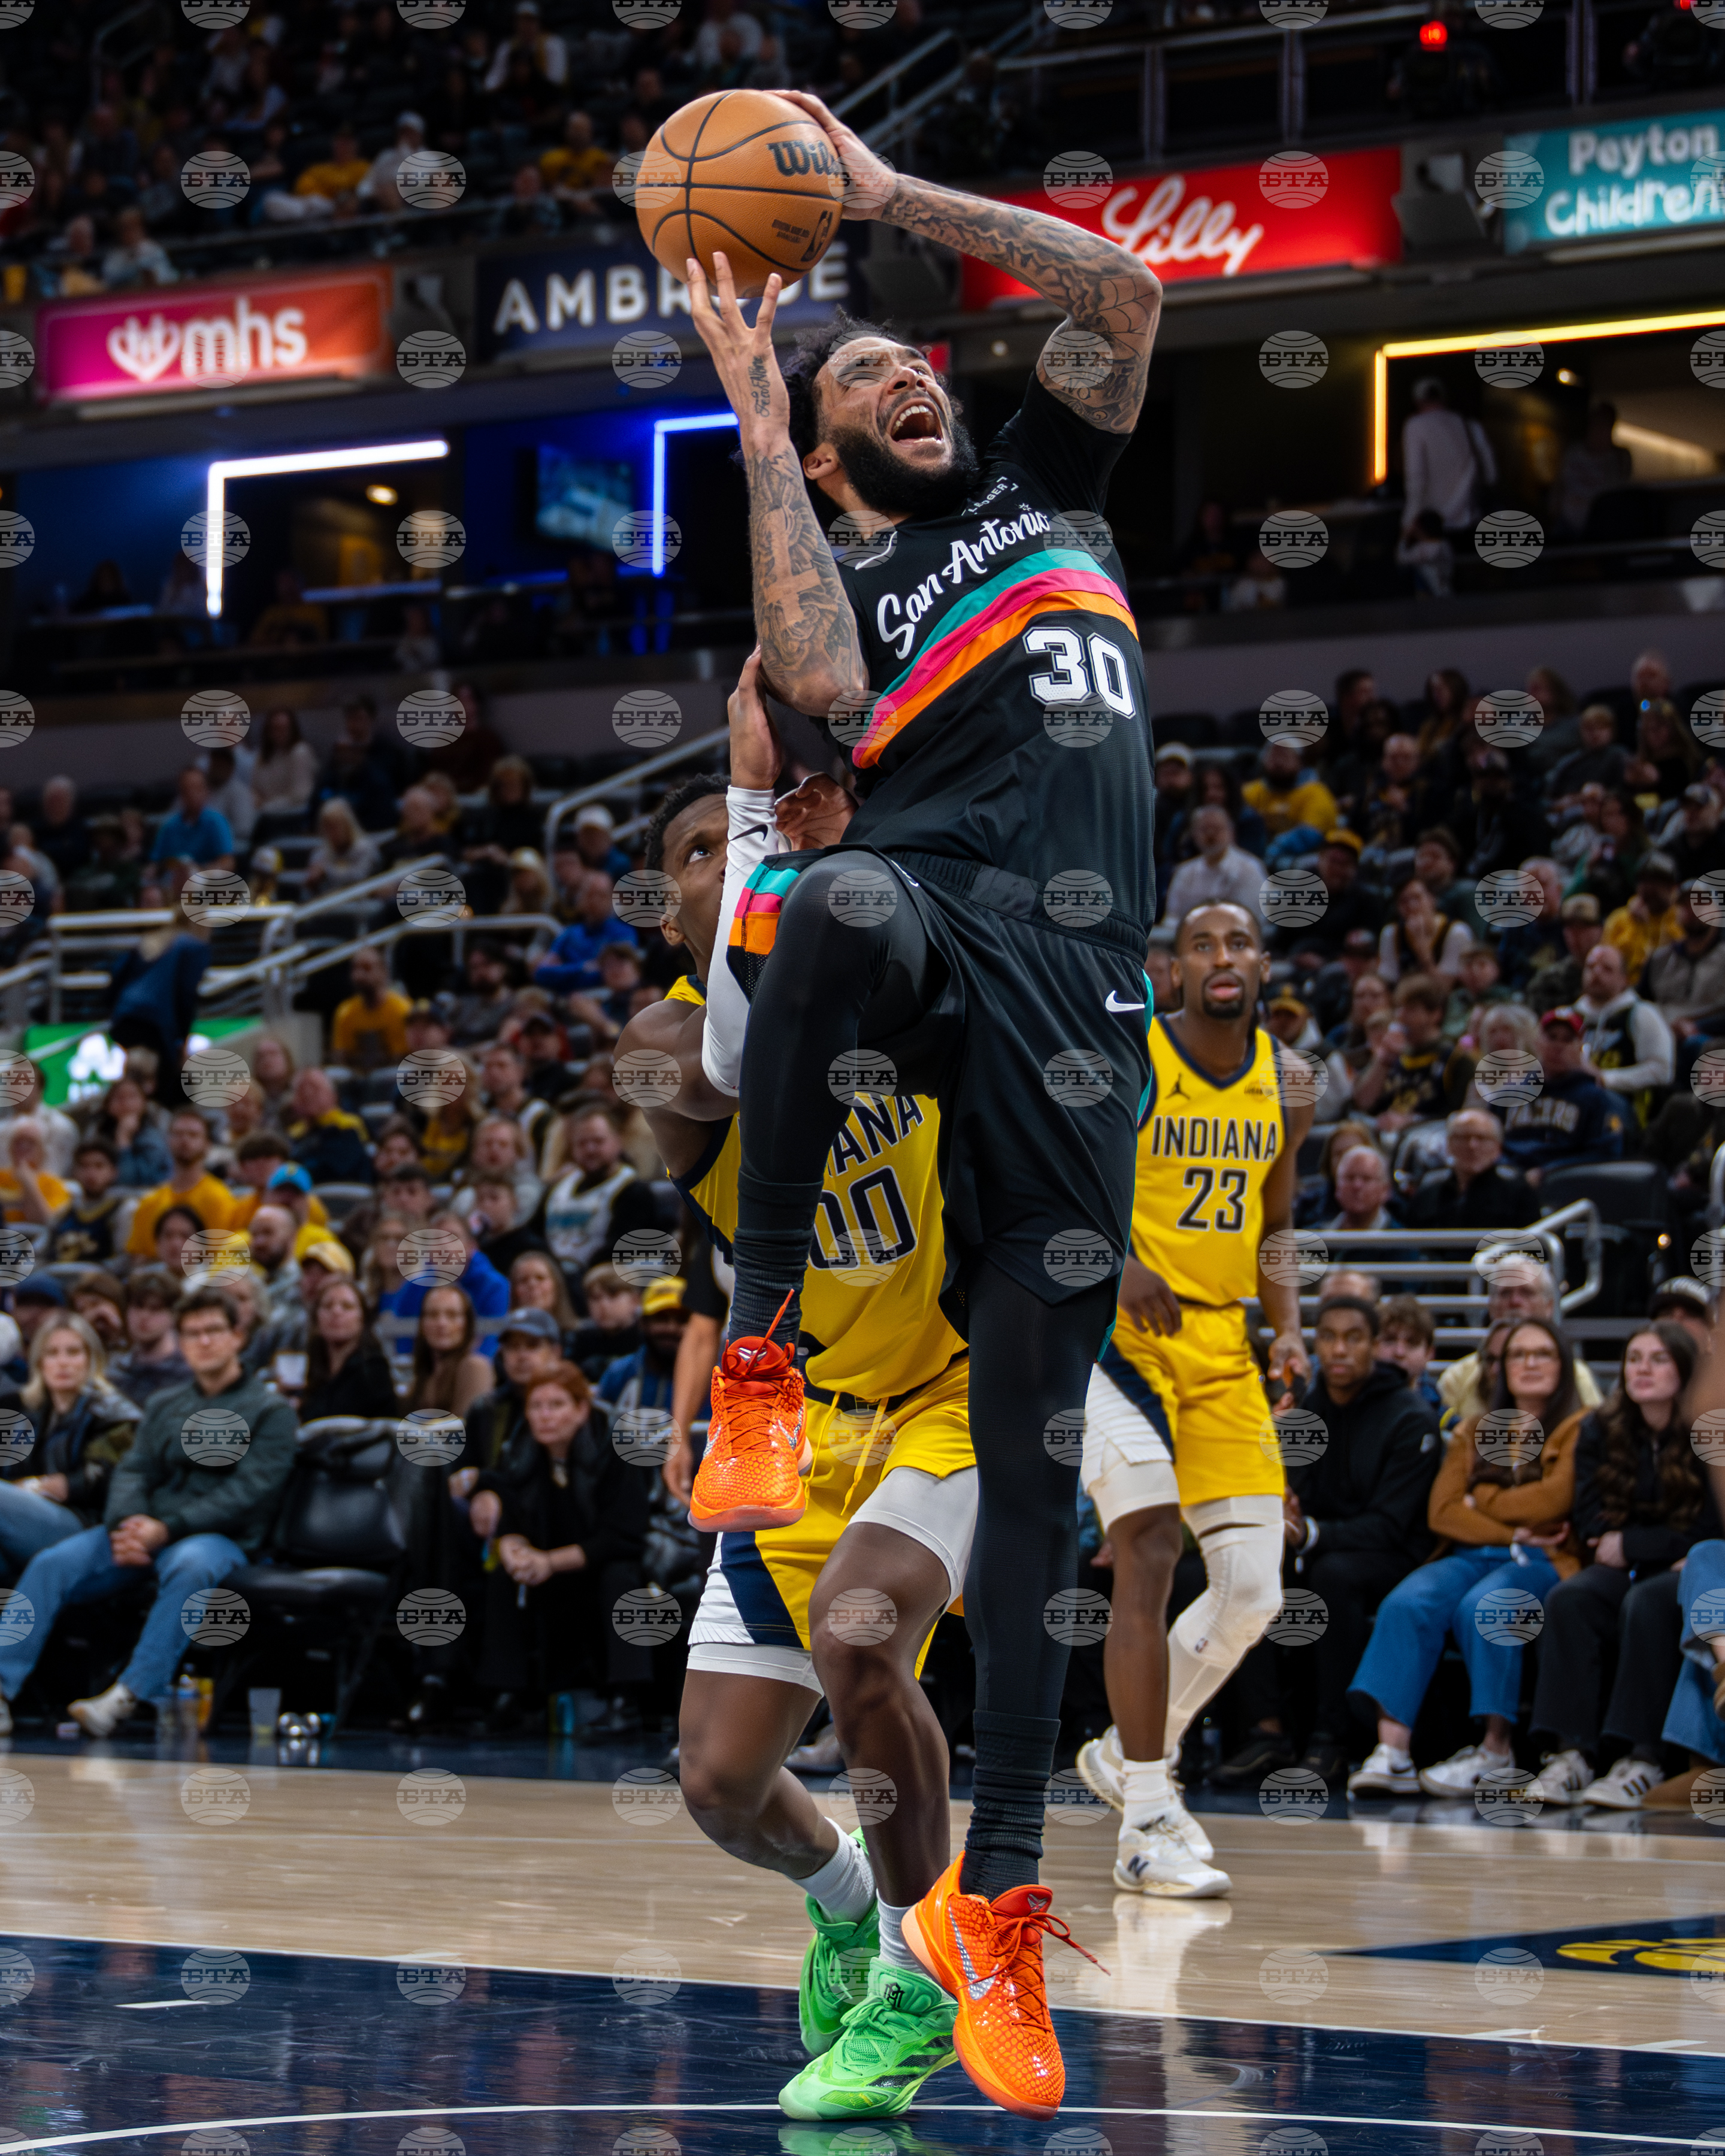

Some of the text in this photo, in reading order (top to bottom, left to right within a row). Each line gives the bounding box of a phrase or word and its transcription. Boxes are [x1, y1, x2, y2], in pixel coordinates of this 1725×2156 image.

[1567, 122, 1720, 178] Peyton
[1101, 172, 1265, 278] Lilly
[184, 296, 307, 376] mhs
[968, 483, 1008, 513] LEDGER
[877, 510, 1051, 659] San Antonio
[1022, 626, 1136, 719] 30
[827, 1094, 925, 1179] ANA
[1151, 1115, 1279, 1161] INDIANA
[807, 1164, 918, 1271] 00
[1175, 1166, 1248, 1233] 23
